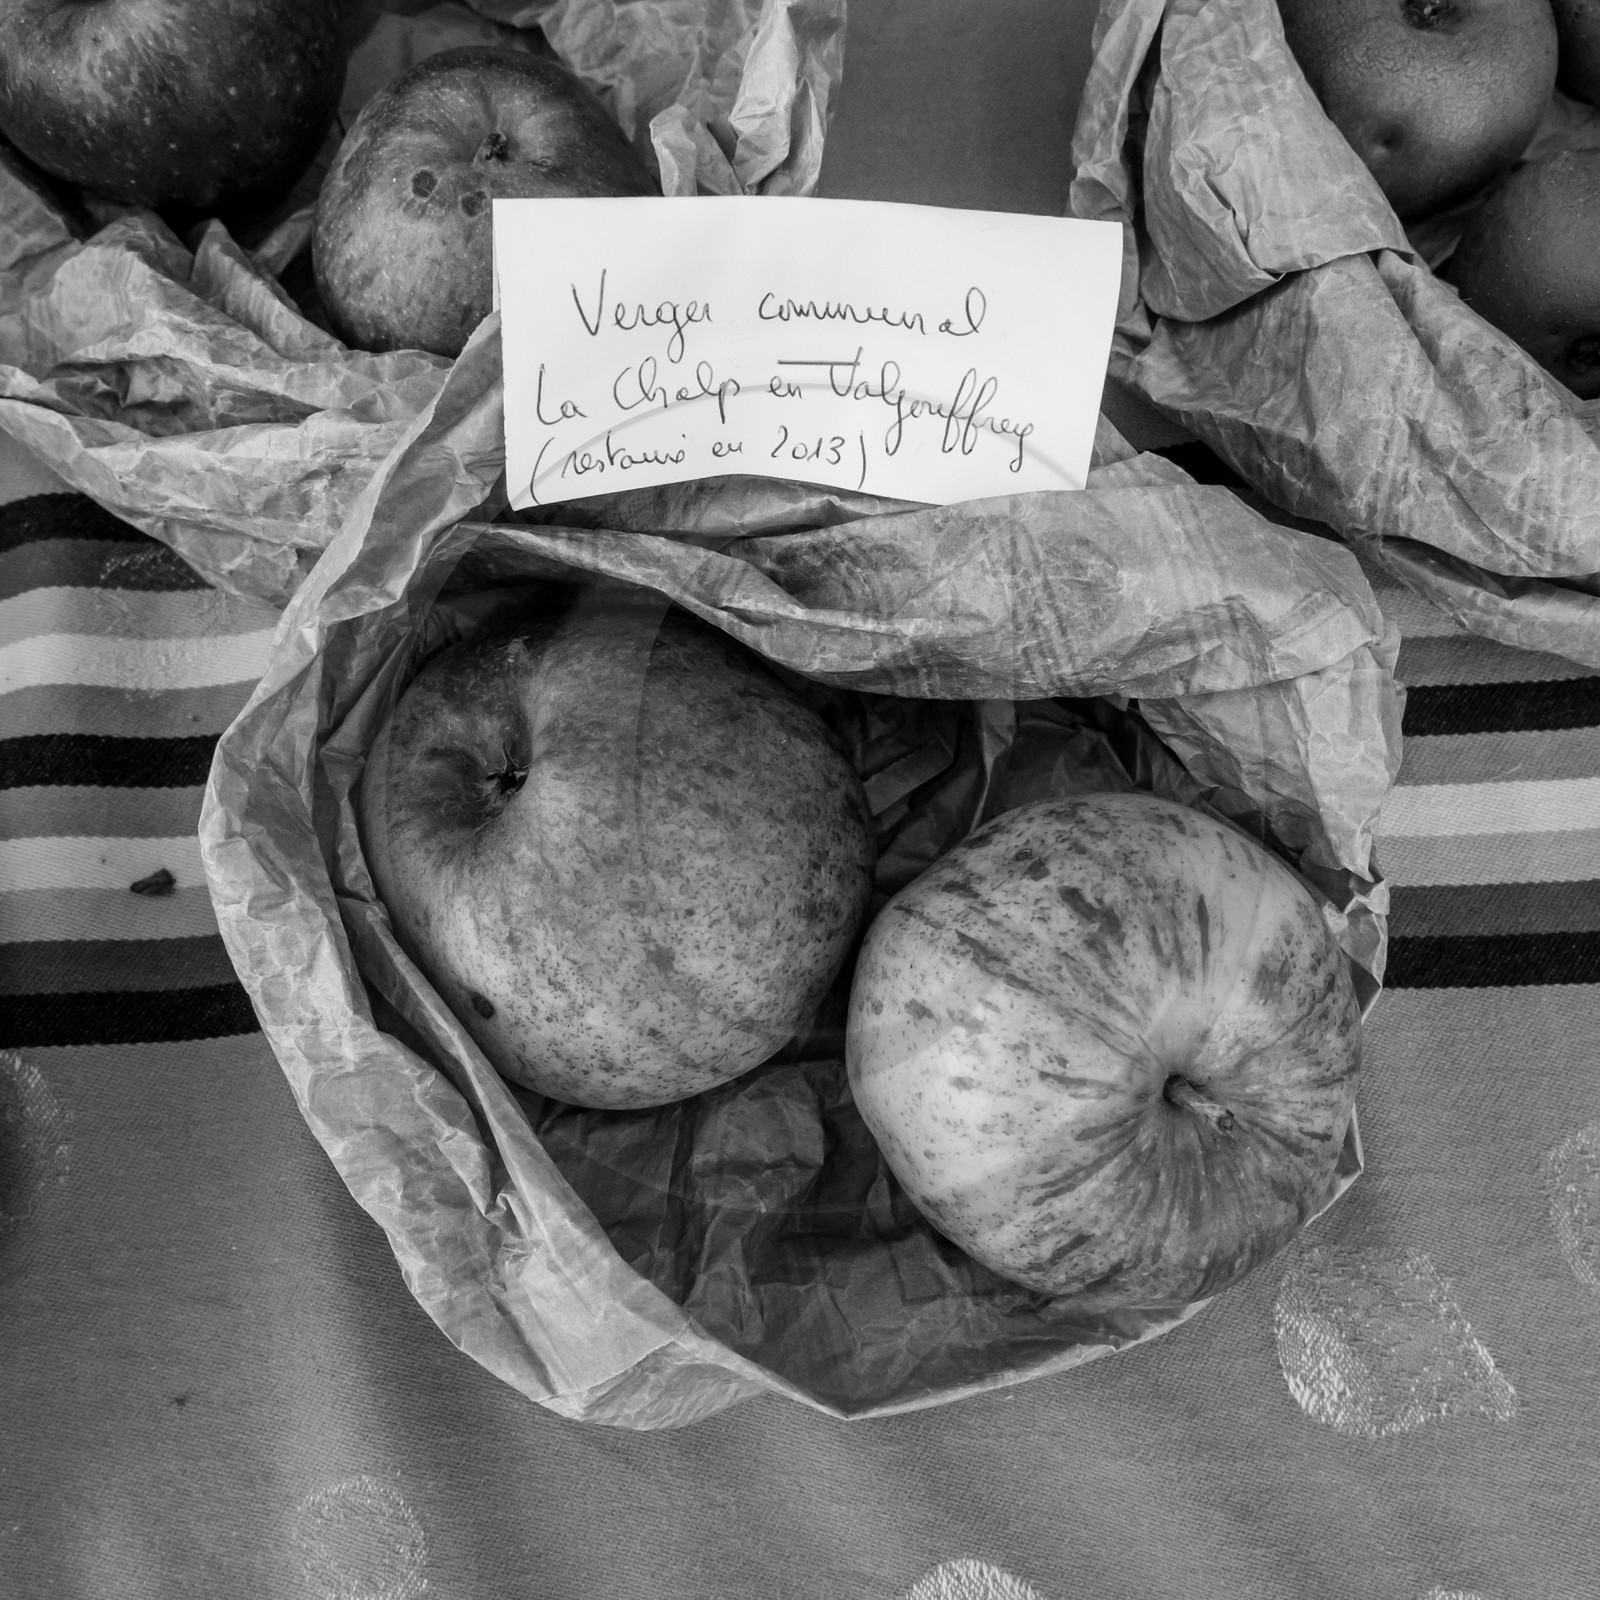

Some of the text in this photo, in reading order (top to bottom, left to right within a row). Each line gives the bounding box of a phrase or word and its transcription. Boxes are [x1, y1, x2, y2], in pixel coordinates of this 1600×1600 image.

[571, 267, 987, 364] Verger communal
[536, 363, 588, 425] La
[613, 356, 742, 424] Chalp
[766, 375, 803, 399] en
[711, 441, 744, 458] en
[770, 425, 867, 490] 2013)
